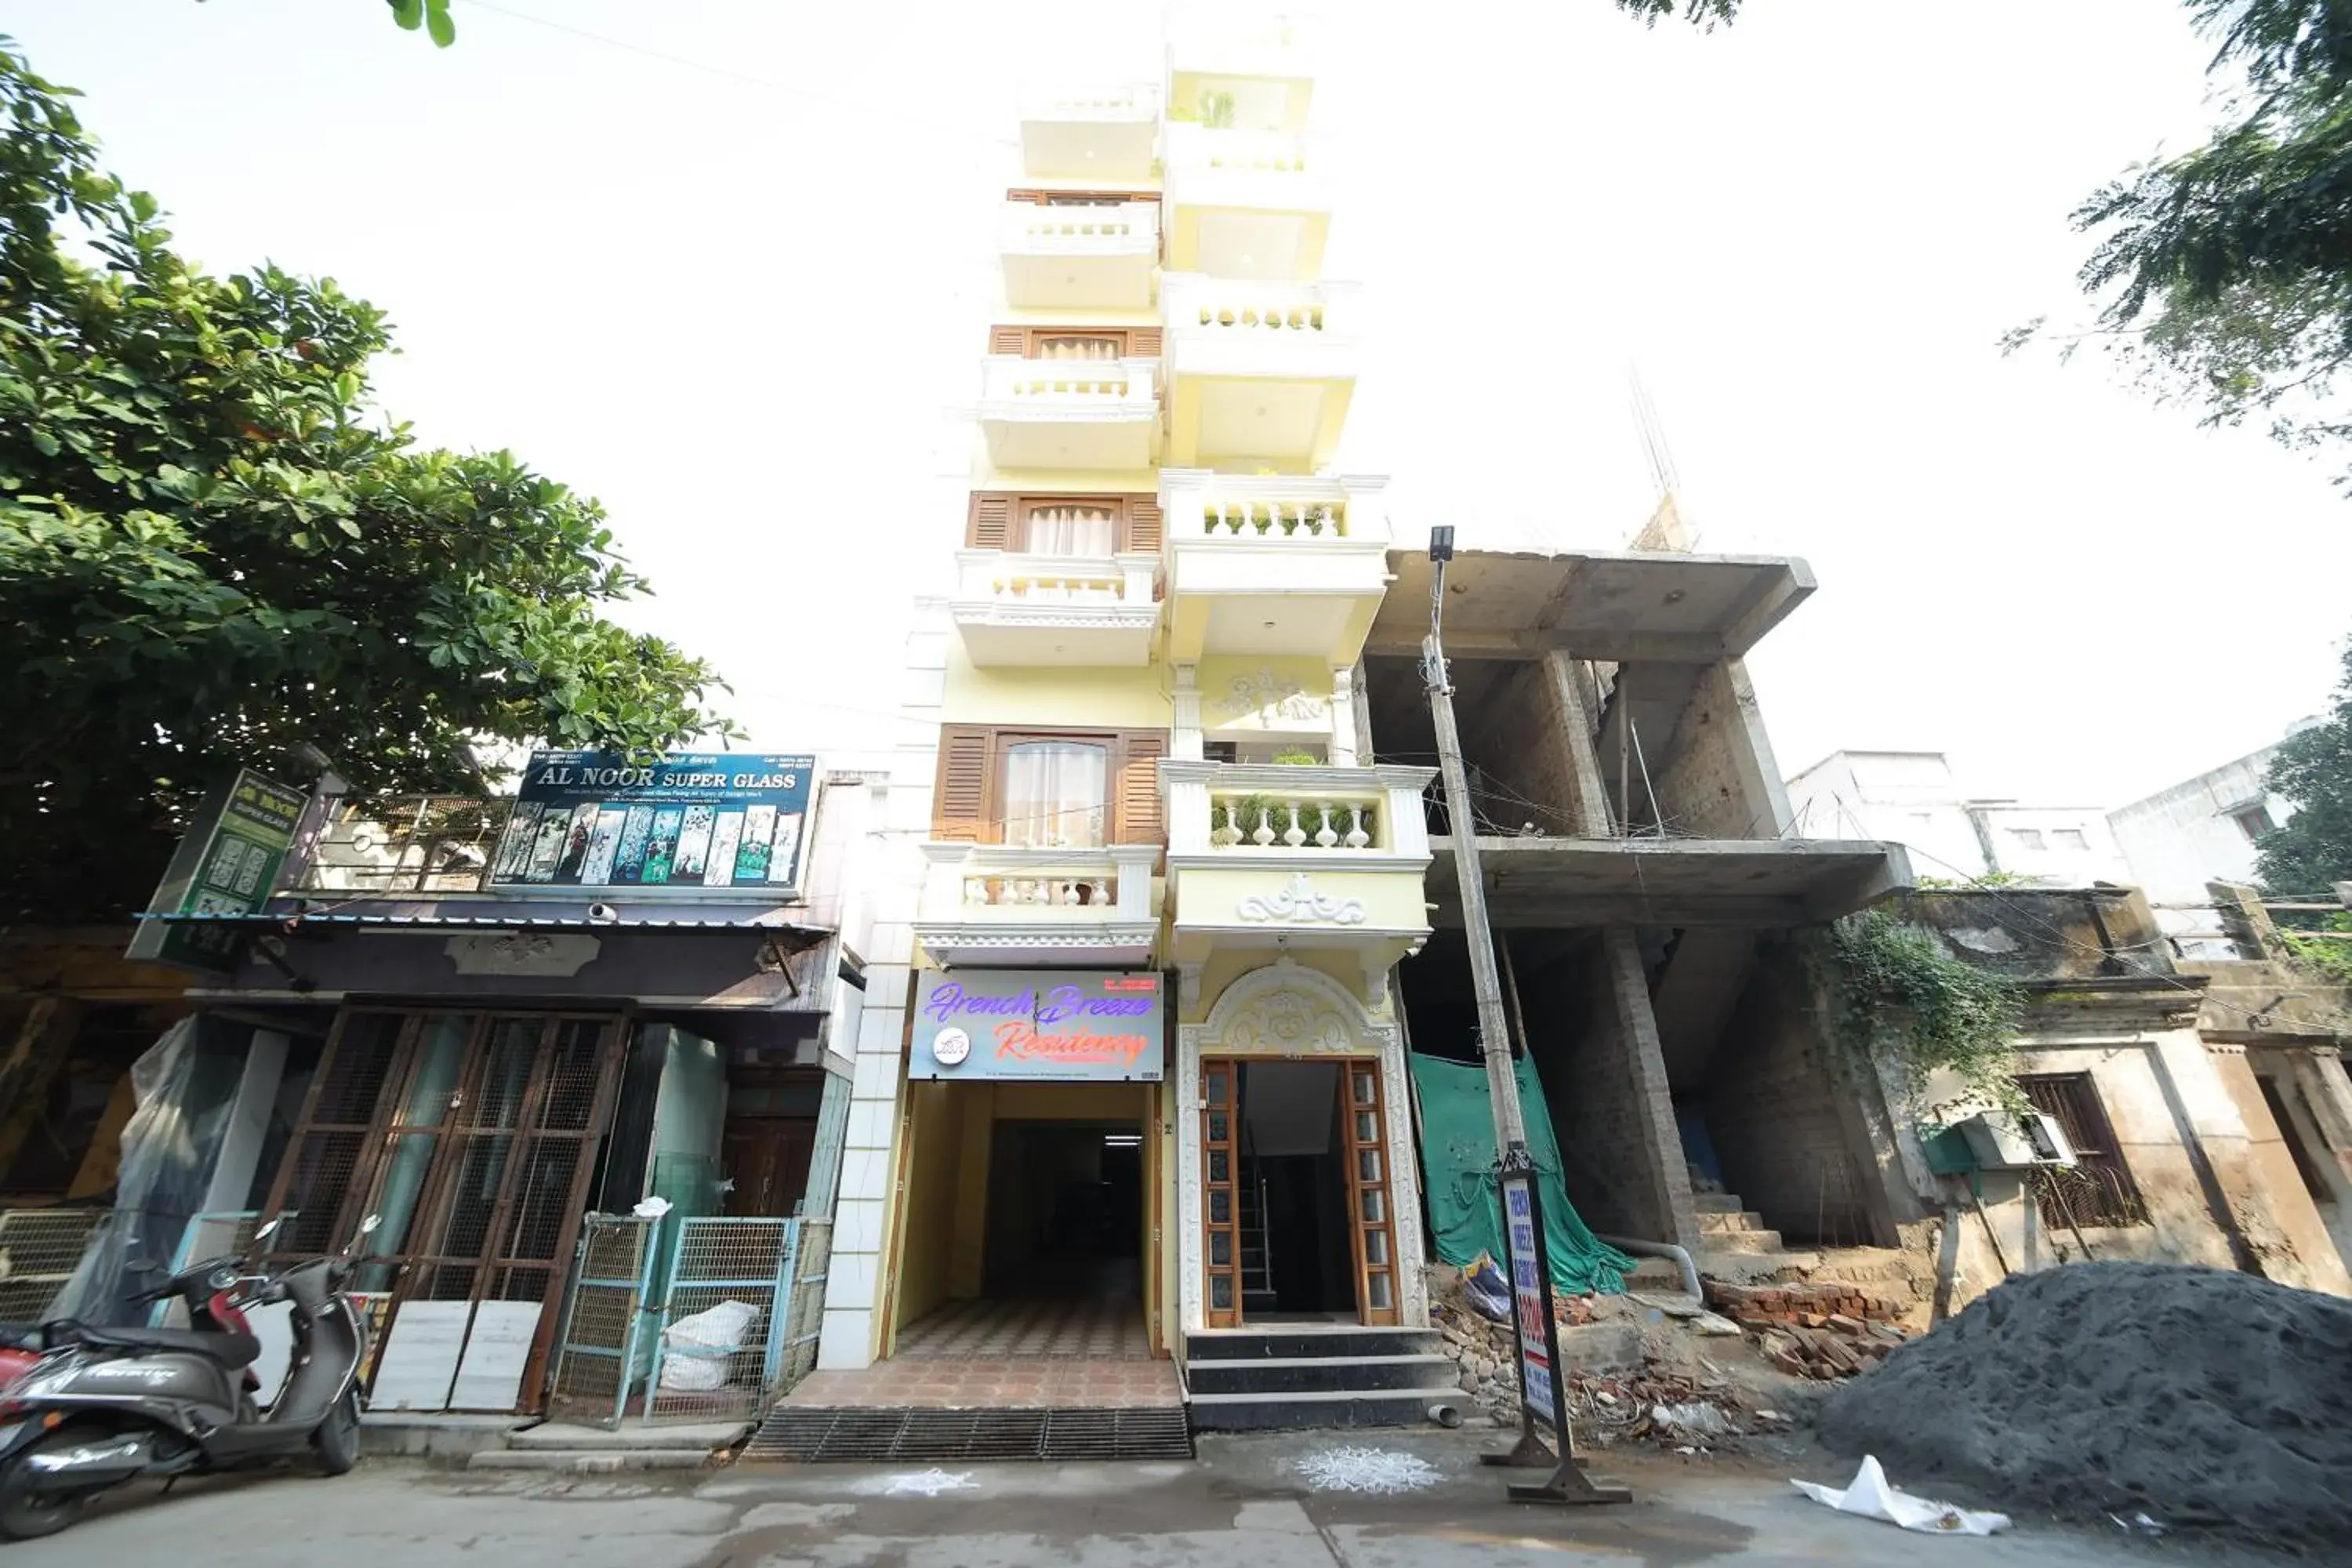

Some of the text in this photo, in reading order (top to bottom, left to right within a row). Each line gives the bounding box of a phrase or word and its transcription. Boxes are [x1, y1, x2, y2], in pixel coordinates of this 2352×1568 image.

[536, 767, 796, 789] AL NOOR SUPER GLASS
